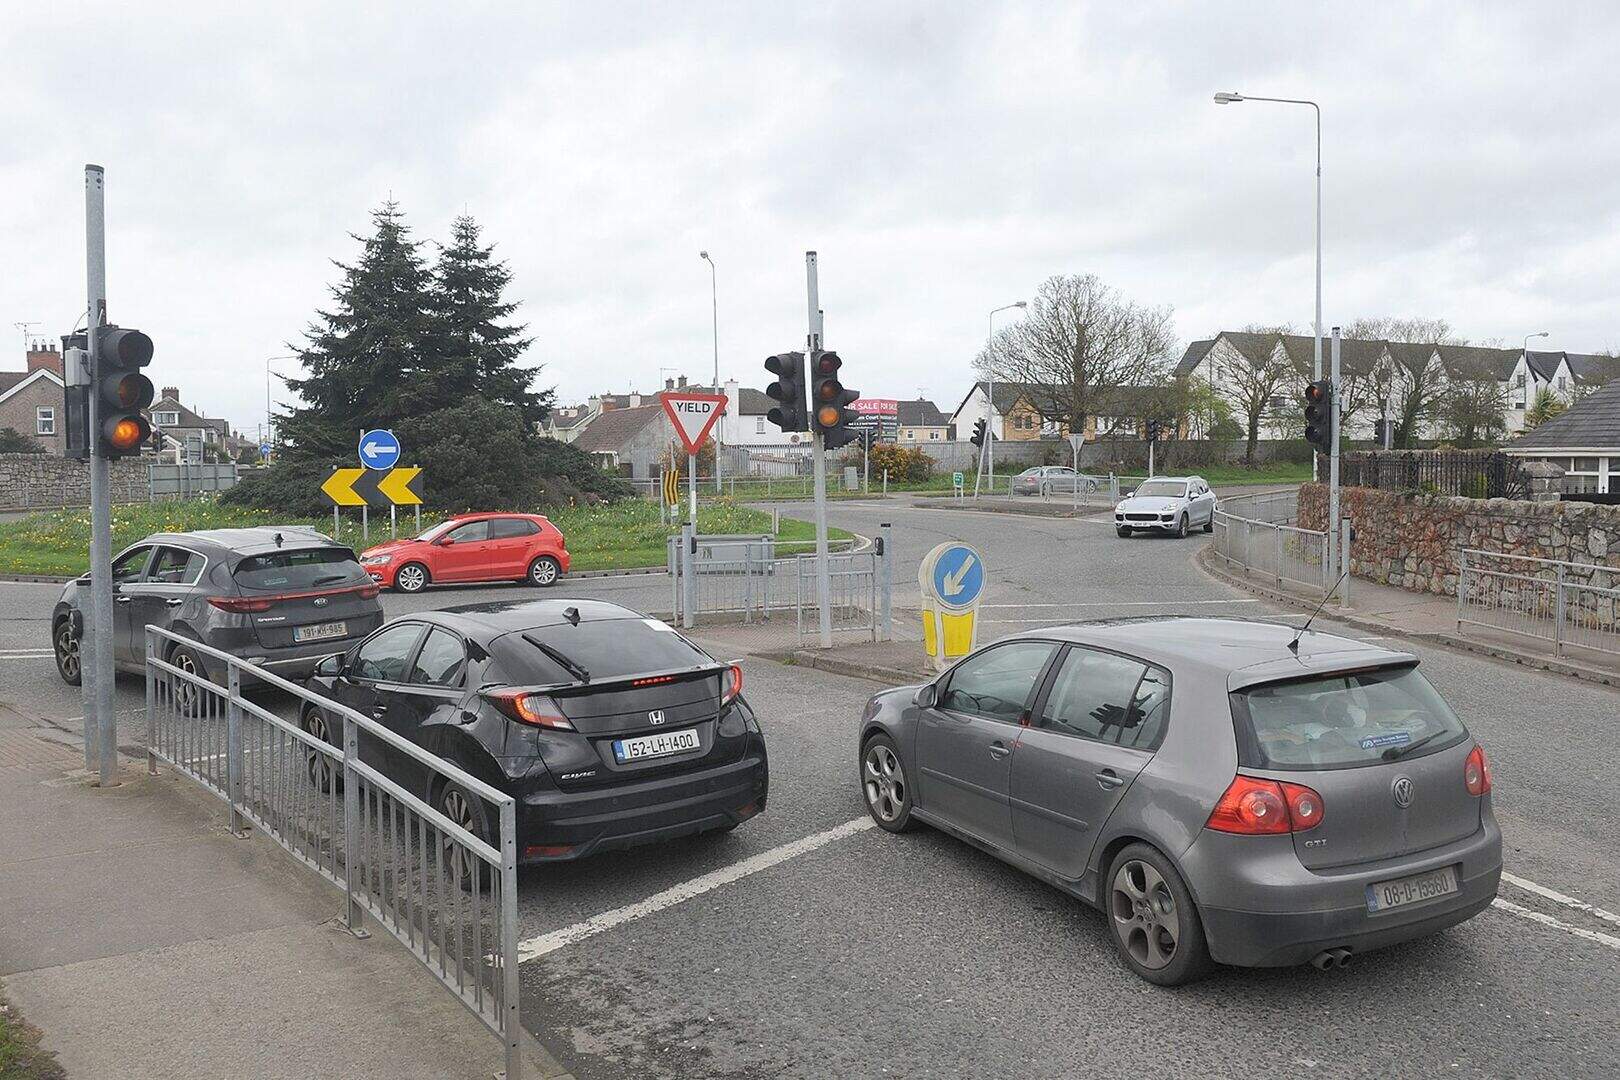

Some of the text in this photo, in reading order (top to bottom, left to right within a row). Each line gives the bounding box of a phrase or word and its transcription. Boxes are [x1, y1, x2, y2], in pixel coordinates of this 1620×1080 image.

[676, 402, 710, 413] YIELD
[858, 402, 878, 410] SALE
[628, 733, 694, 757] 152-LH-1400
[561, 770, 596, 780] CIVIC
[1304, 838, 1327, 849] GTI
